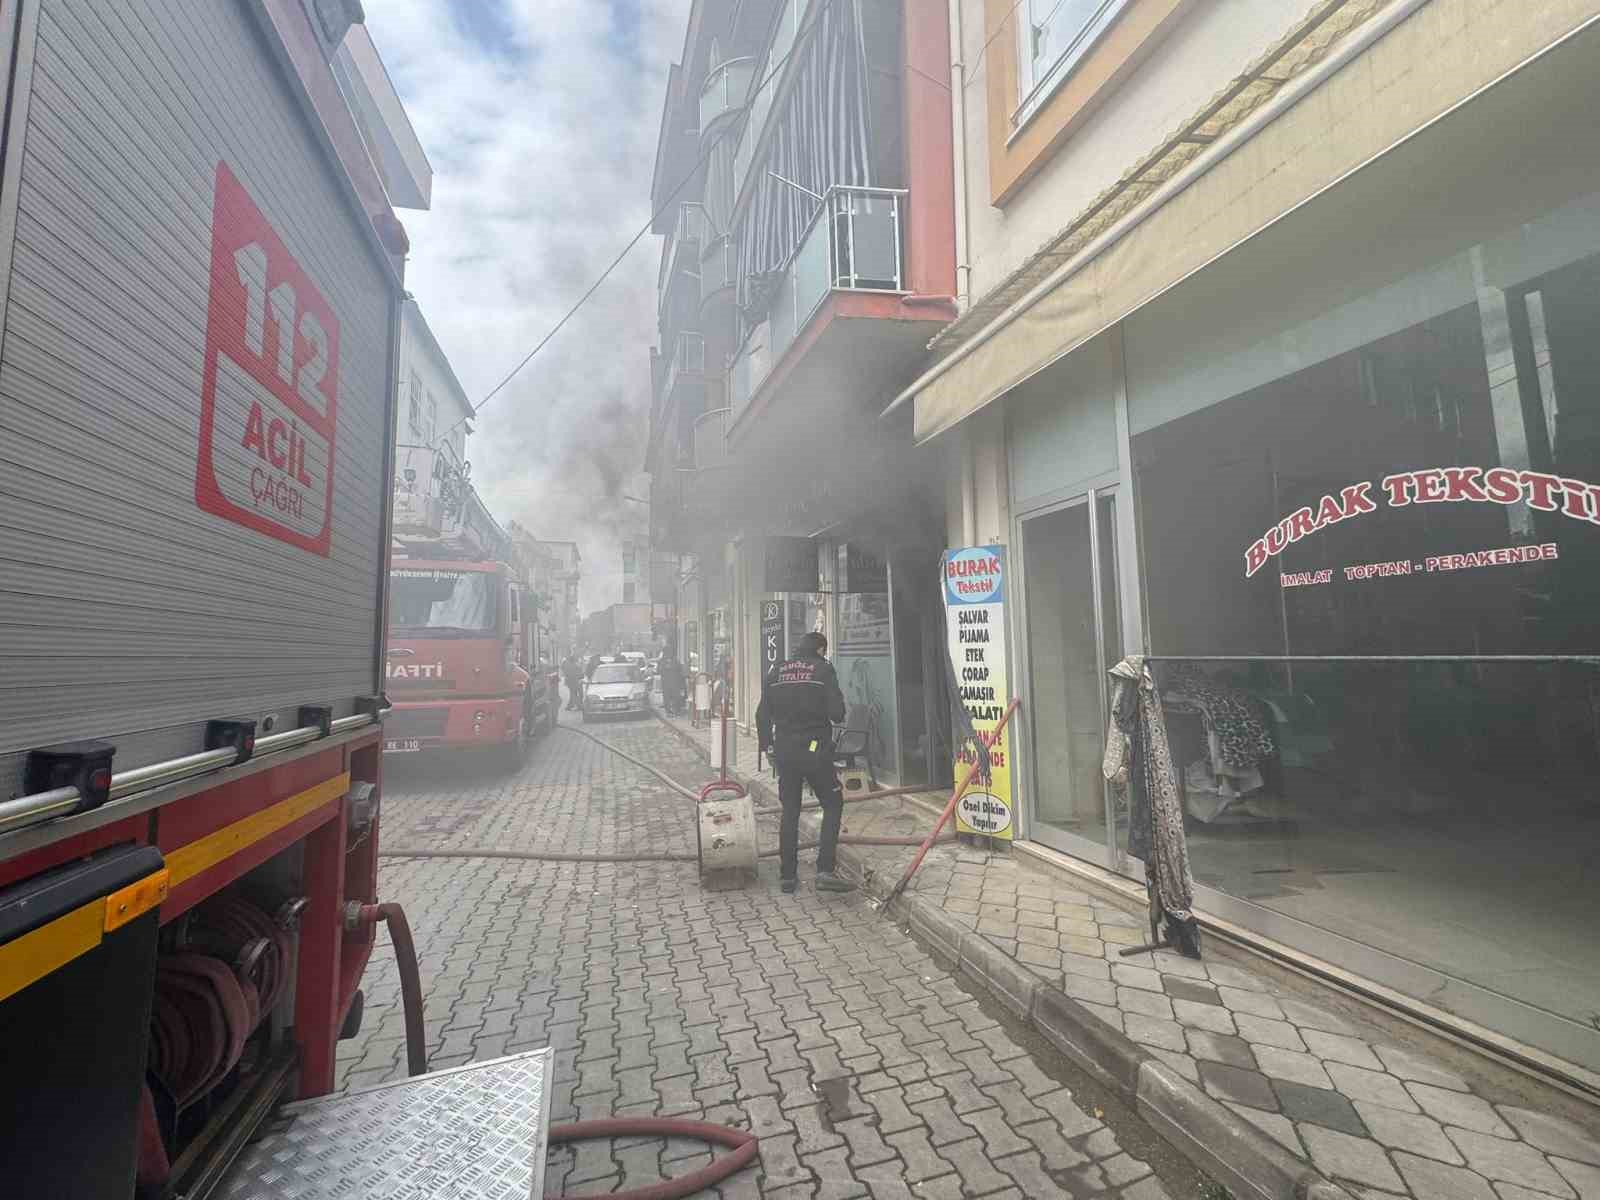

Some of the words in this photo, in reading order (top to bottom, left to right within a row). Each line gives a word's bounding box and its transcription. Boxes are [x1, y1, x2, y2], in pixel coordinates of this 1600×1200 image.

[233, 241, 328, 418] 112
[241, 400, 312, 489] ACİL
[249, 467, 305, 521] ÇAĞRI
[1245, 481, 1377, 577] BURAK
[947, 556, 1001, 578] BURAK
[1343, 560, 1412, 581] TOPTAN
[1426, 543, 1559, 573] PERAKENDE
[956, 578, 993, 594] Tekstil
[965, 648, 985, 662] ETEK
